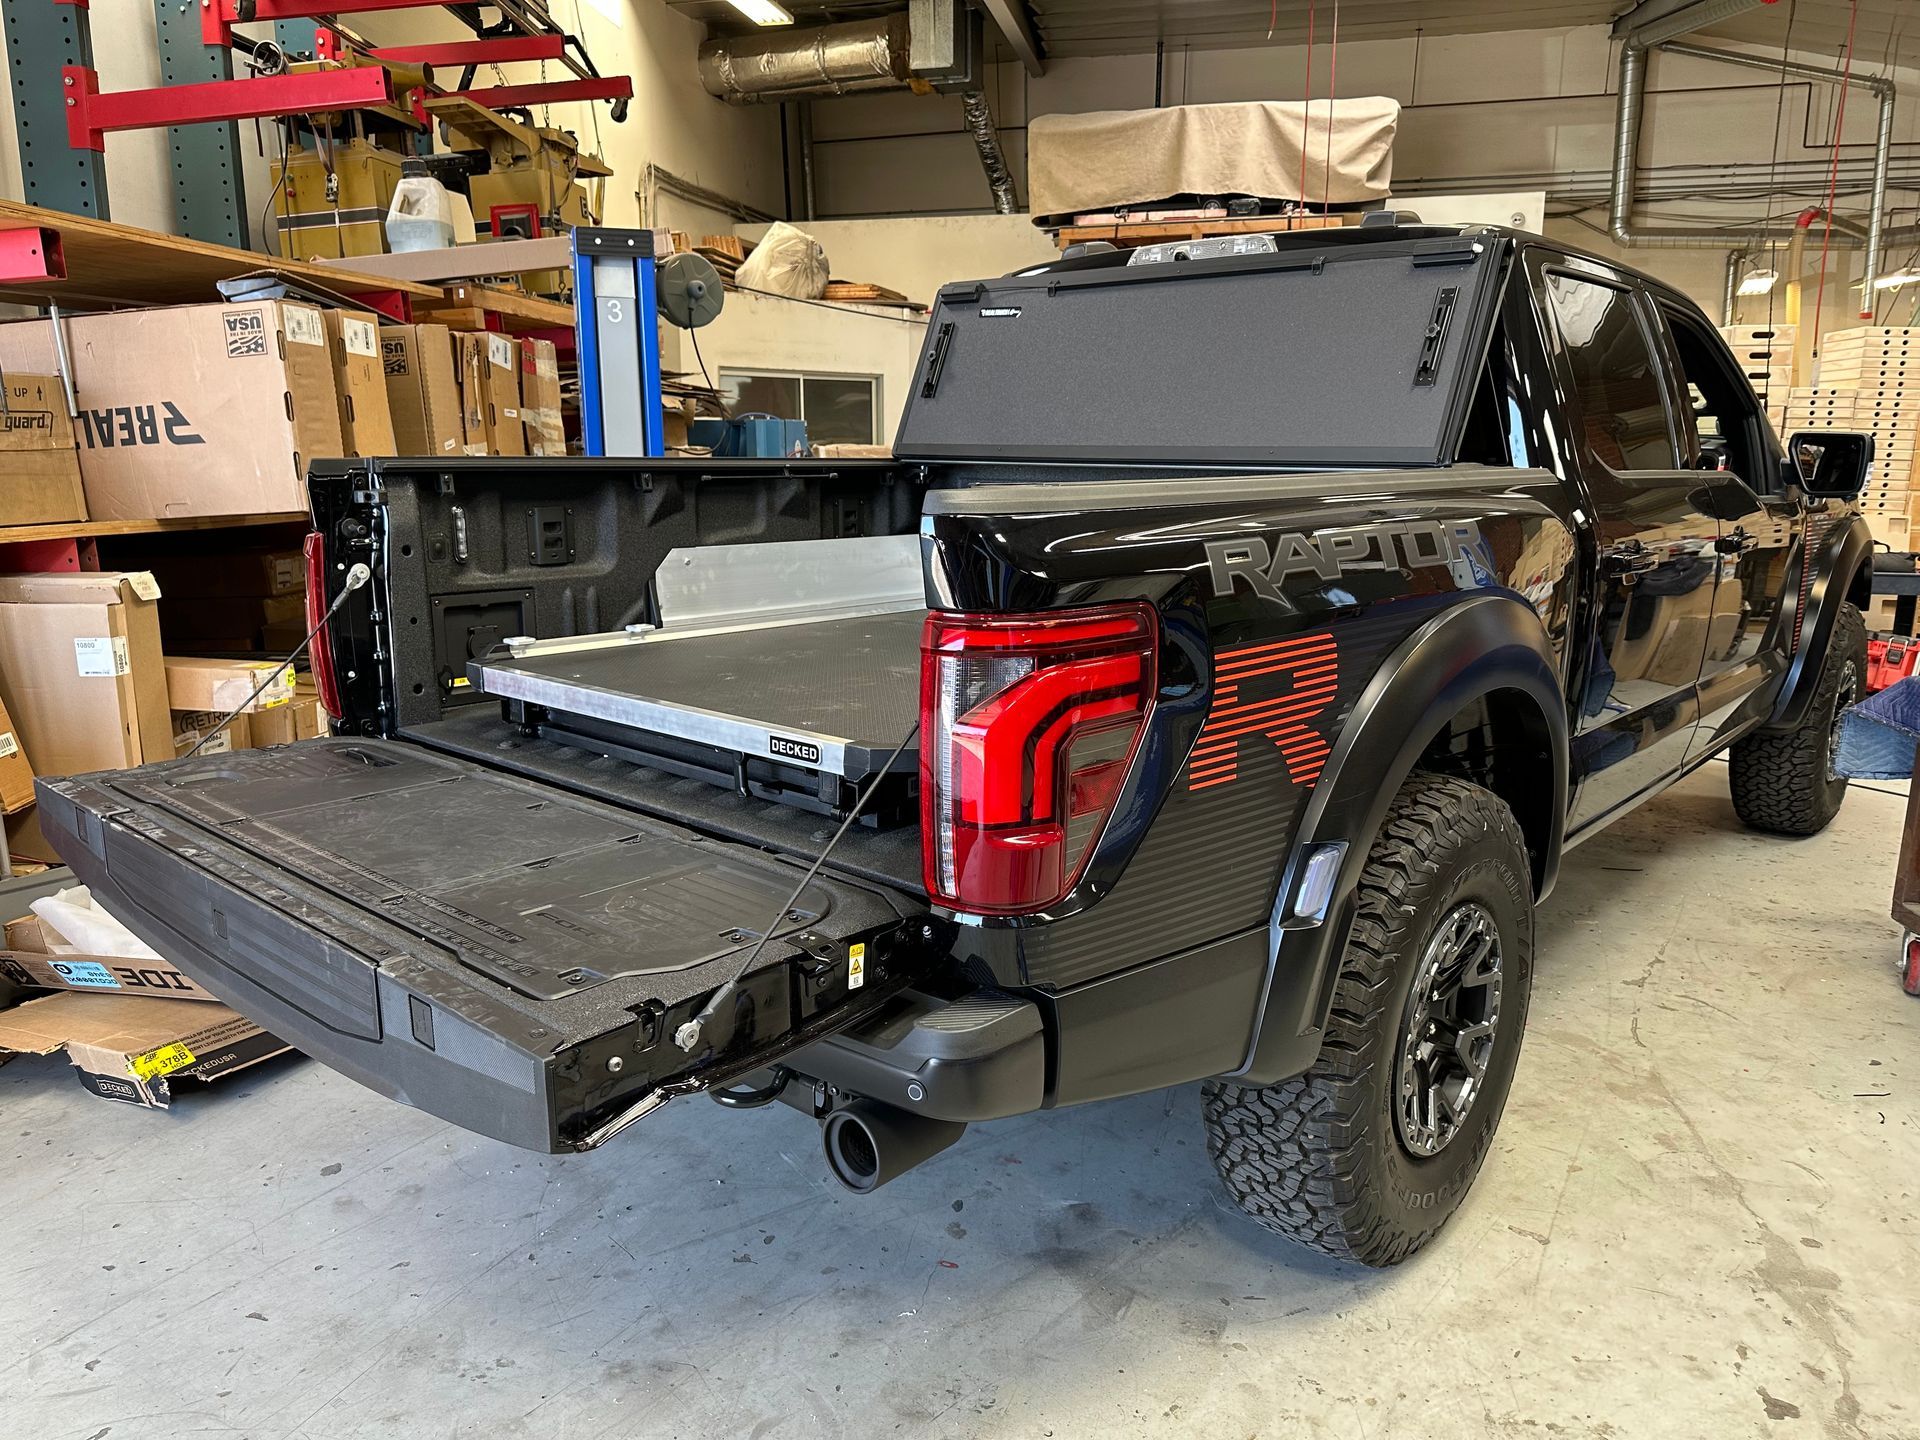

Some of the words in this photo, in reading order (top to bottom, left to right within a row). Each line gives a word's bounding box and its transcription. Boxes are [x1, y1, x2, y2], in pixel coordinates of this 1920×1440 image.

[607, 300, 623, 323] 3
[225, 316, 262, 332] USA
[14, 387, 28, 398] UP
[75, 405, 160, 450] REAL
[1203, 520, 1495, 610] RAPTOR
[771, 739, 817, 760] DECKED
[112, 967, 194, 991] IDE
[159, 1051, 189, 1068] 378B
[182, 1053, 238, 1076] ECKEDUSA
[99, 1083, 132, 1095] DECKED
